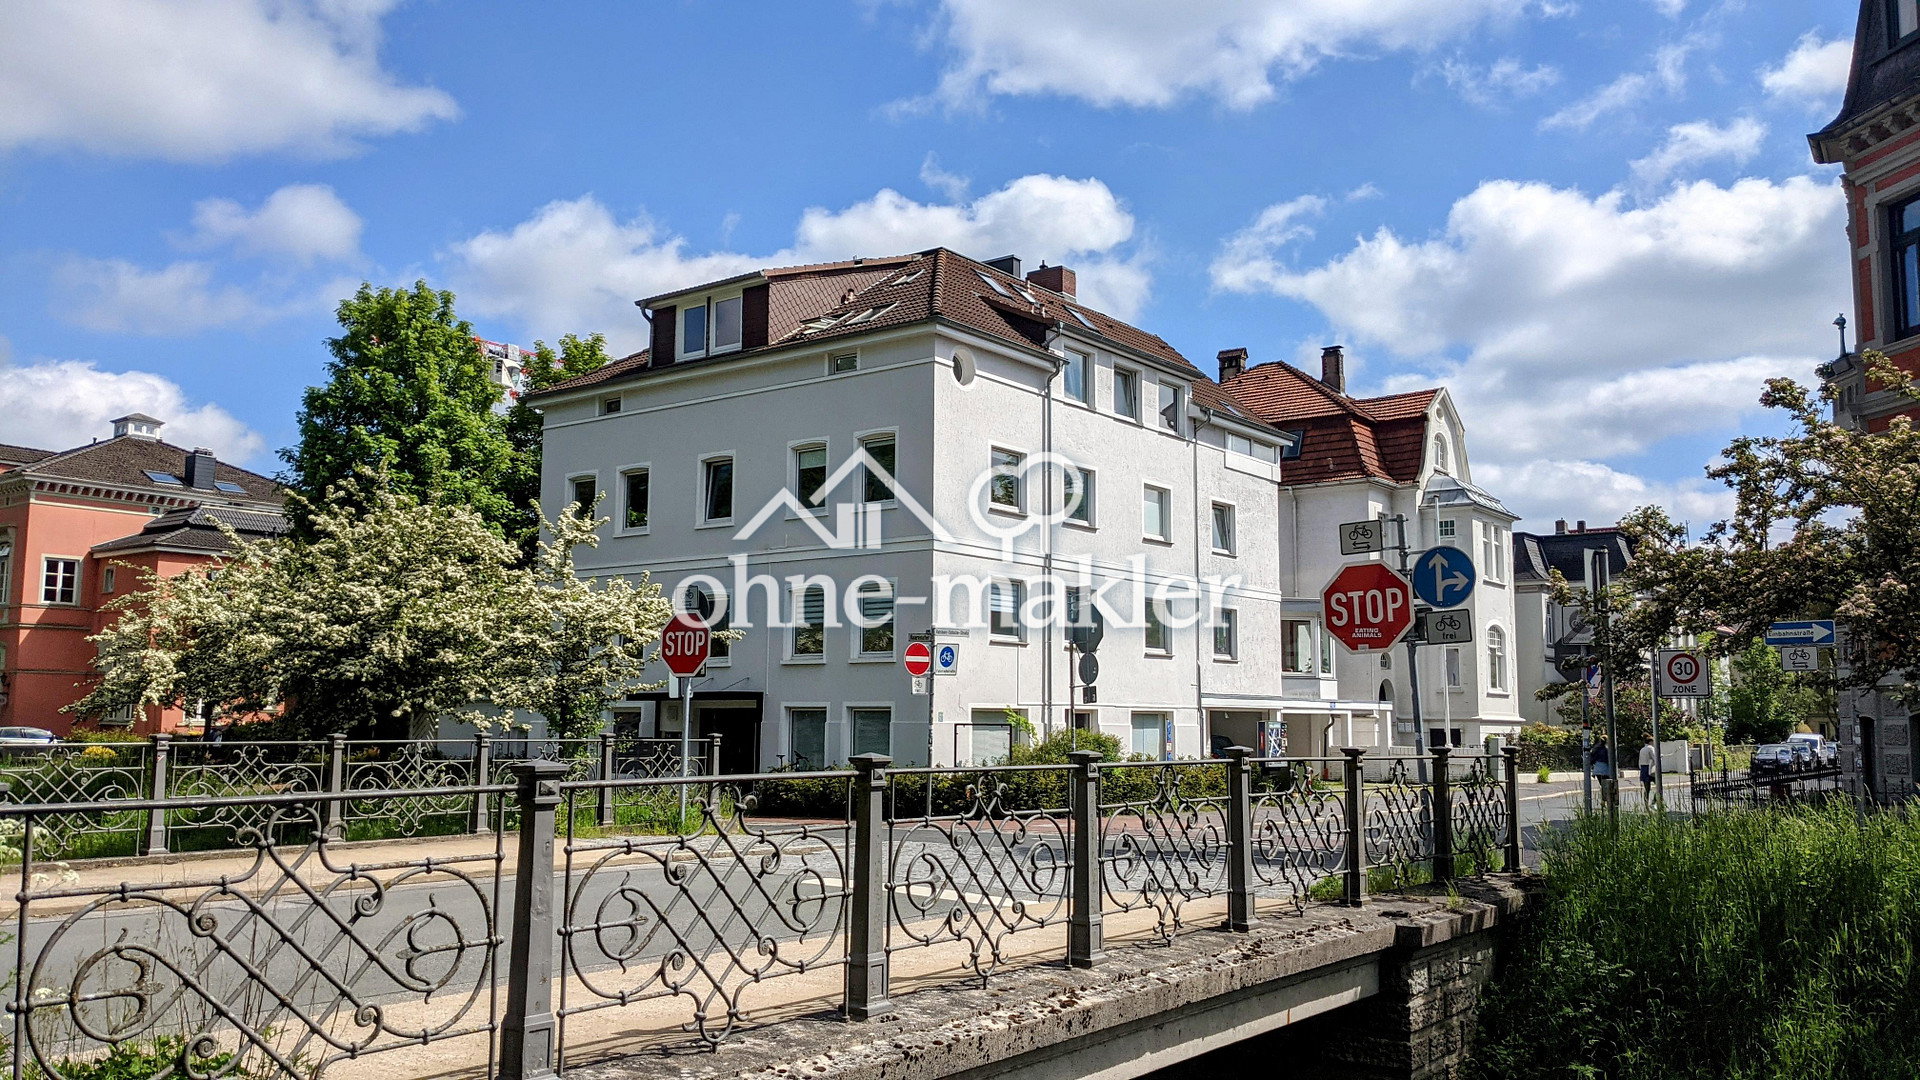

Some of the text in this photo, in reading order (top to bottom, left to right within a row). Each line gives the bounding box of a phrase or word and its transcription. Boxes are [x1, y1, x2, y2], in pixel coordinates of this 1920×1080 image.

[1330, 587, 1403, 627] STOP
[1442, 631, 1457, 640] frei
[1768, 629, 1814, 637] Einbahnstraße
[665, 630, 706, 656] STOP
[1673, 661, 1693, 676] 30
[1672, 685, 1697, 693] ZONE
